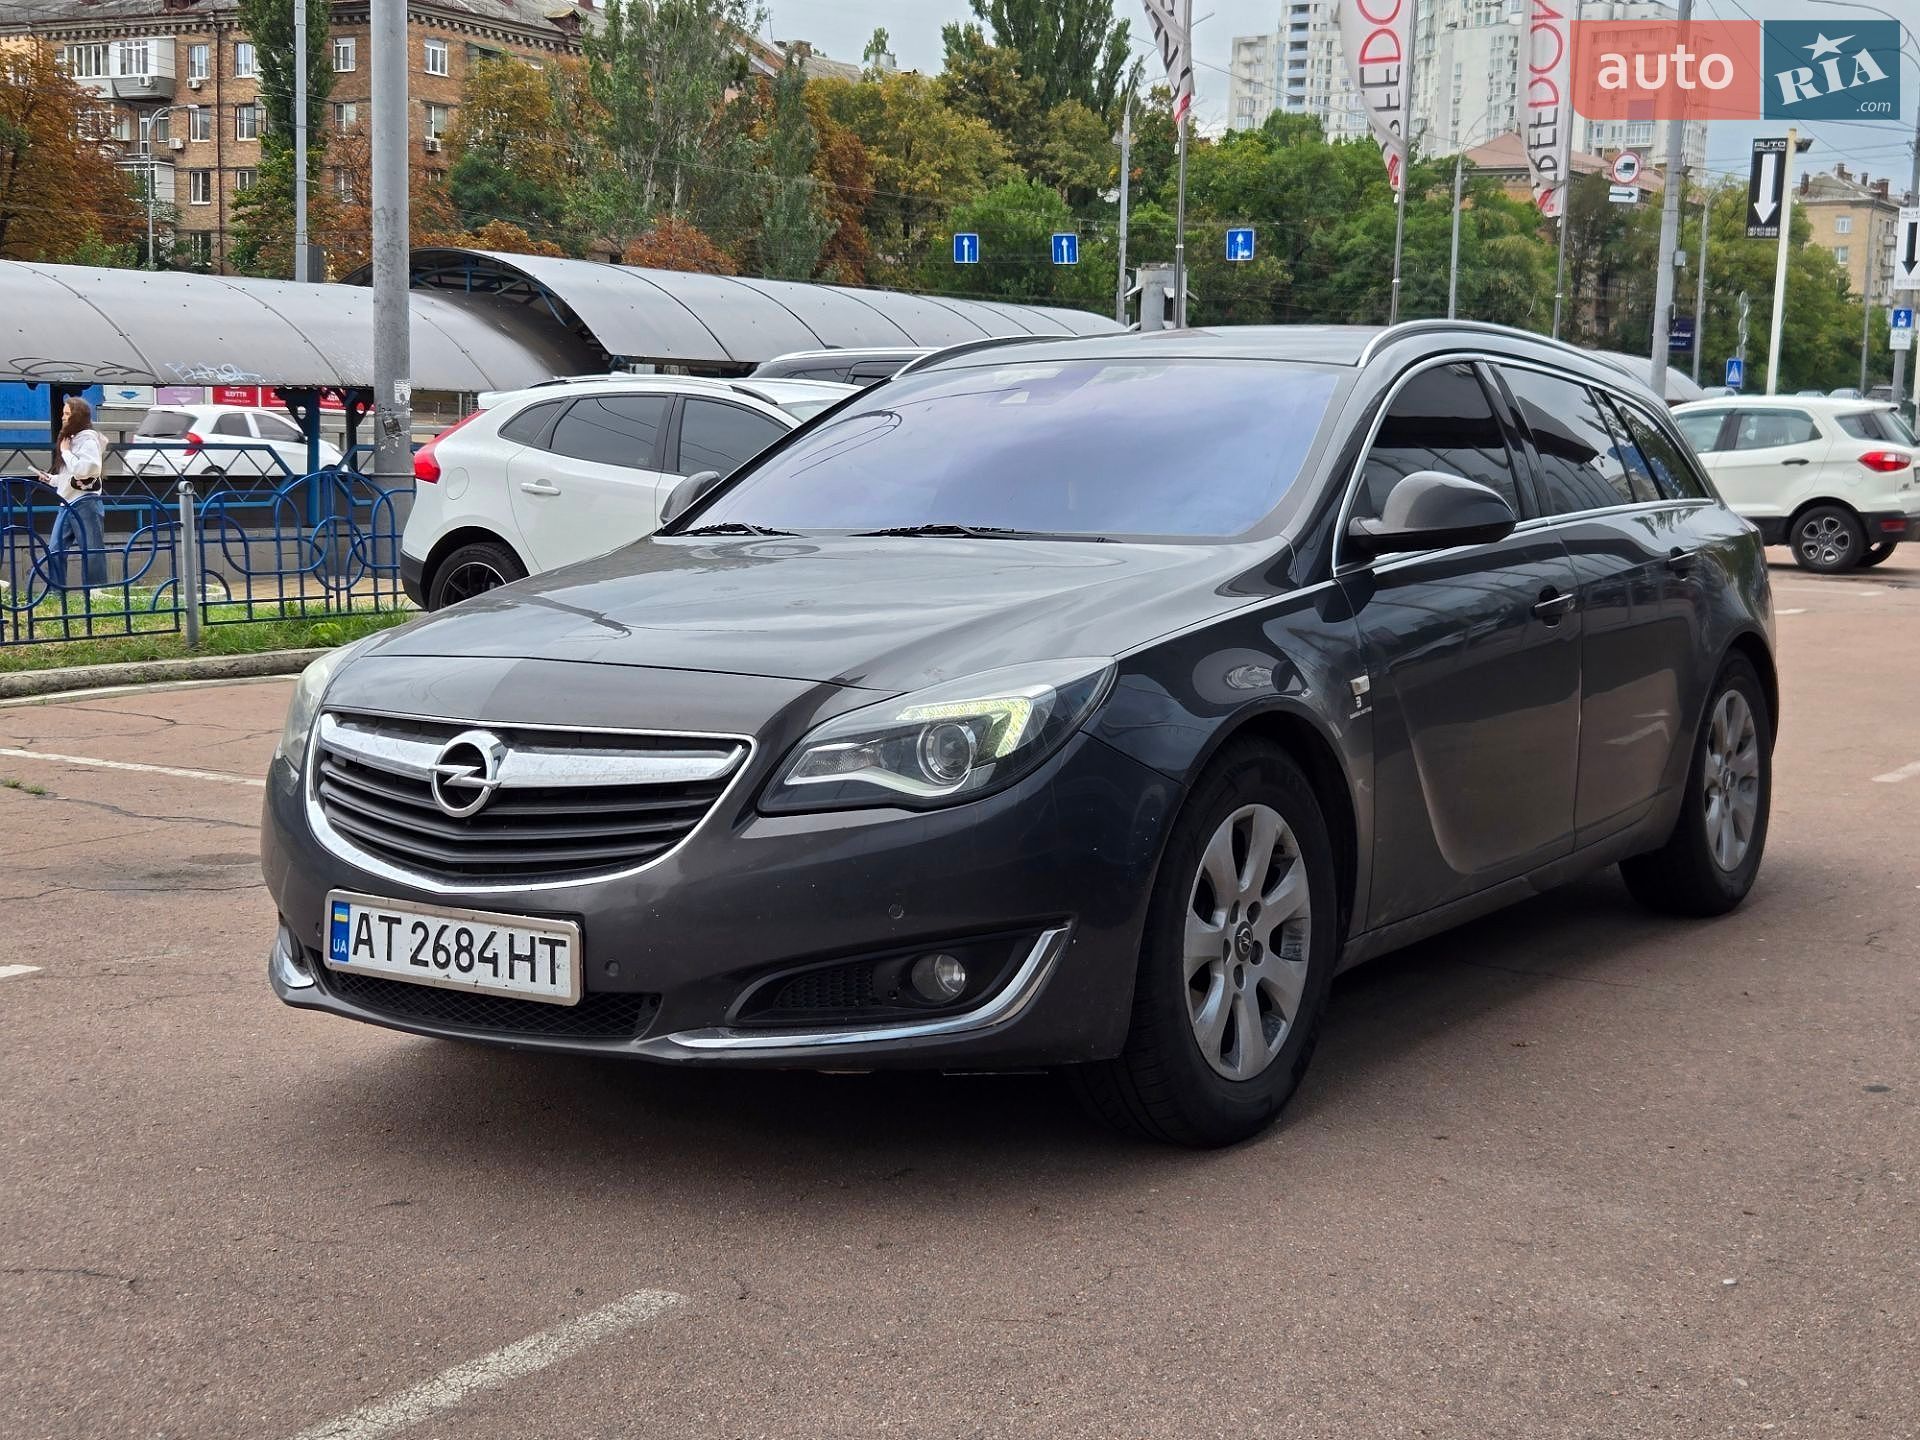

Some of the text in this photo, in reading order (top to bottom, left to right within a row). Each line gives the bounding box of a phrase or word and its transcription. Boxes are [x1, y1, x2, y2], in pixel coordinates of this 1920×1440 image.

[333, 939, 347, 954] UA
[353, 912, 567, 985] AT 2684 HT
